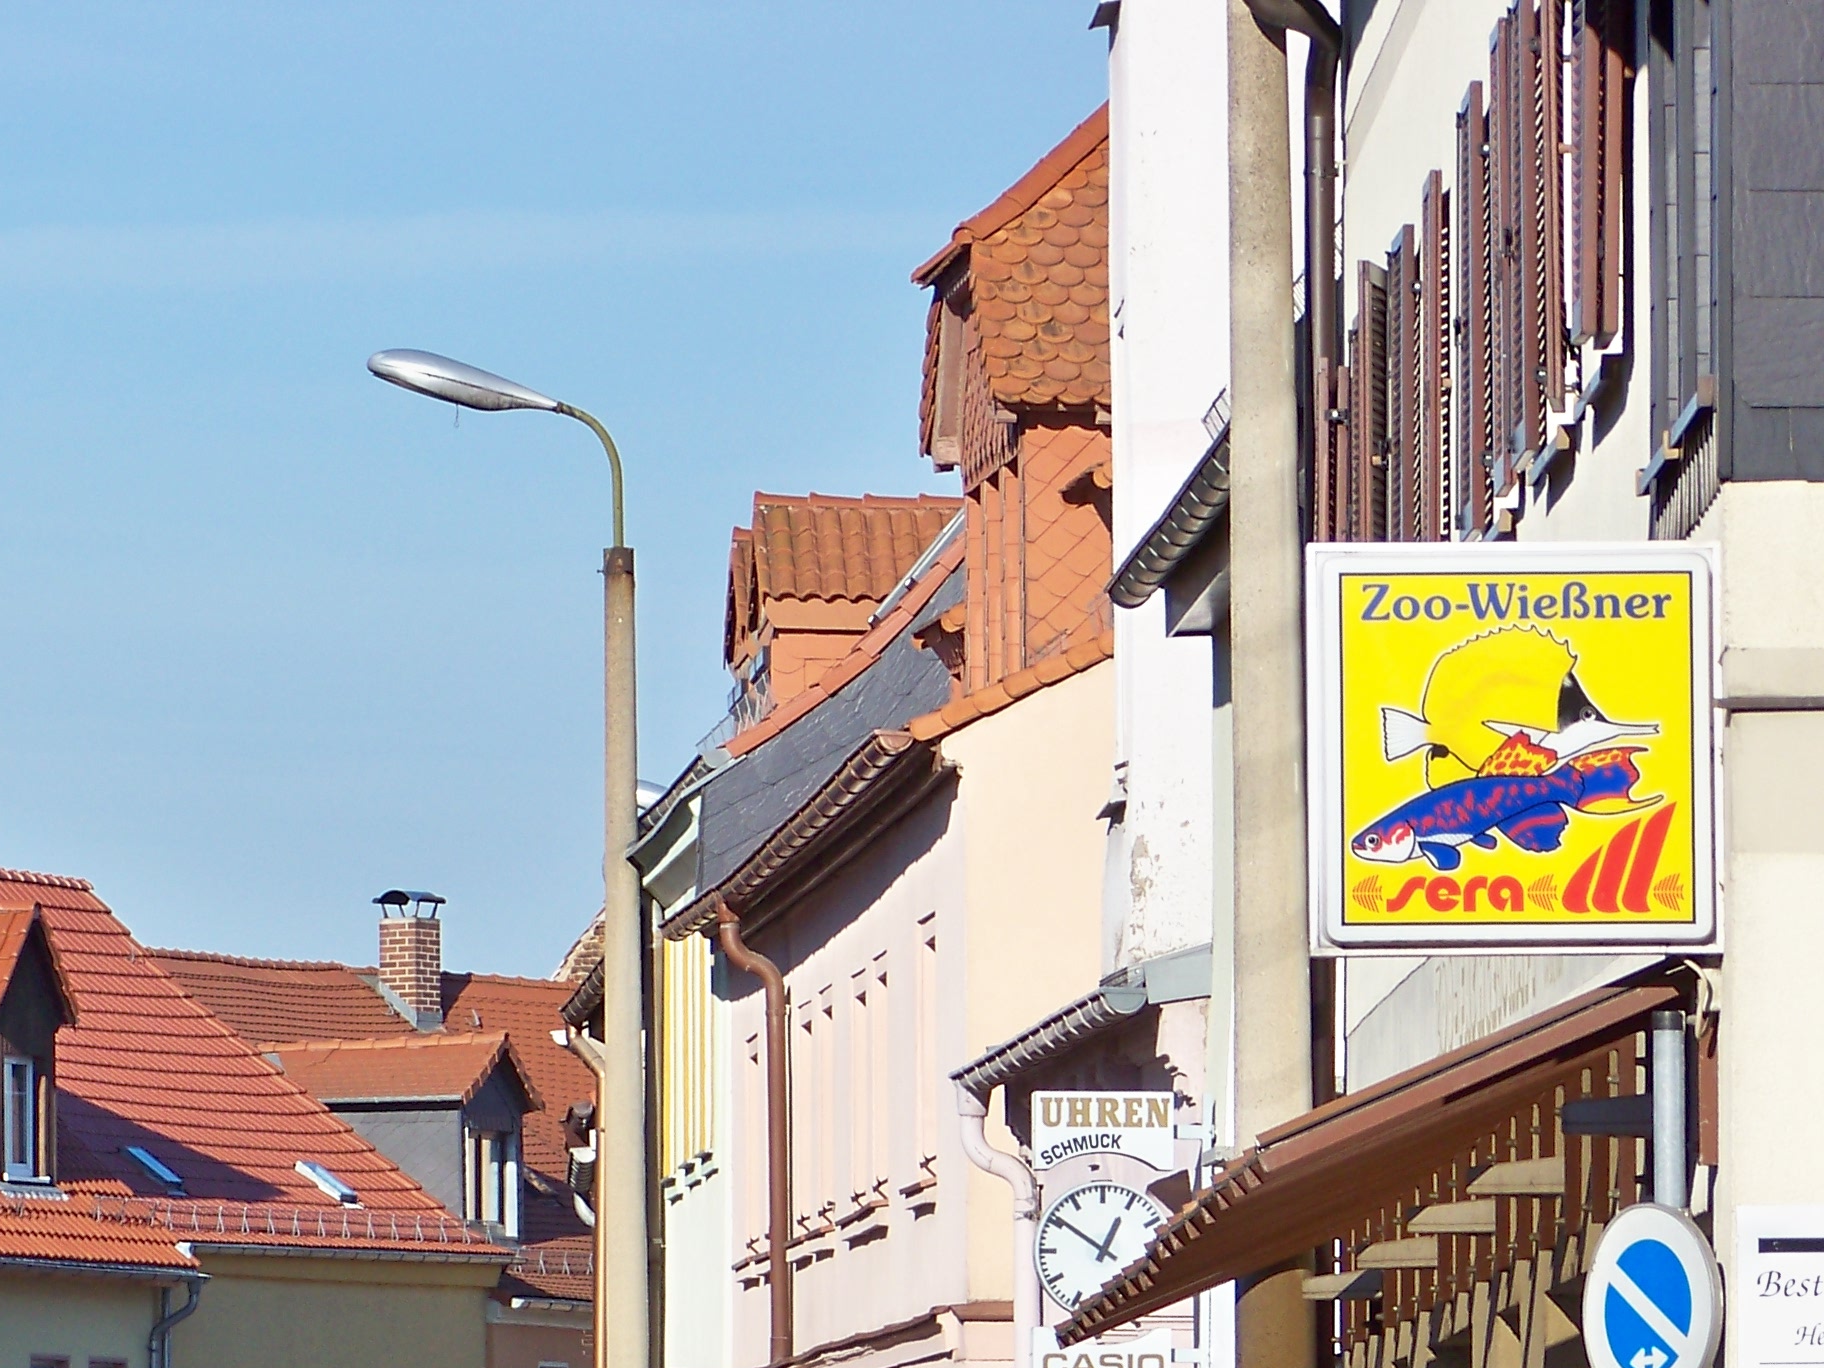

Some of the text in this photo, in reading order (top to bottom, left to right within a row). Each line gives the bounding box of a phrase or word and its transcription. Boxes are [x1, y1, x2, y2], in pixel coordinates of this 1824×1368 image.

[1361, 581, 1672, 621] Zoo-Wießner
[1386, 875, 1525, 912] sera
[1040, 1097, 1171, 1128] UHREN
[1040, 1133, 1123, 1165] SCHMUCK
